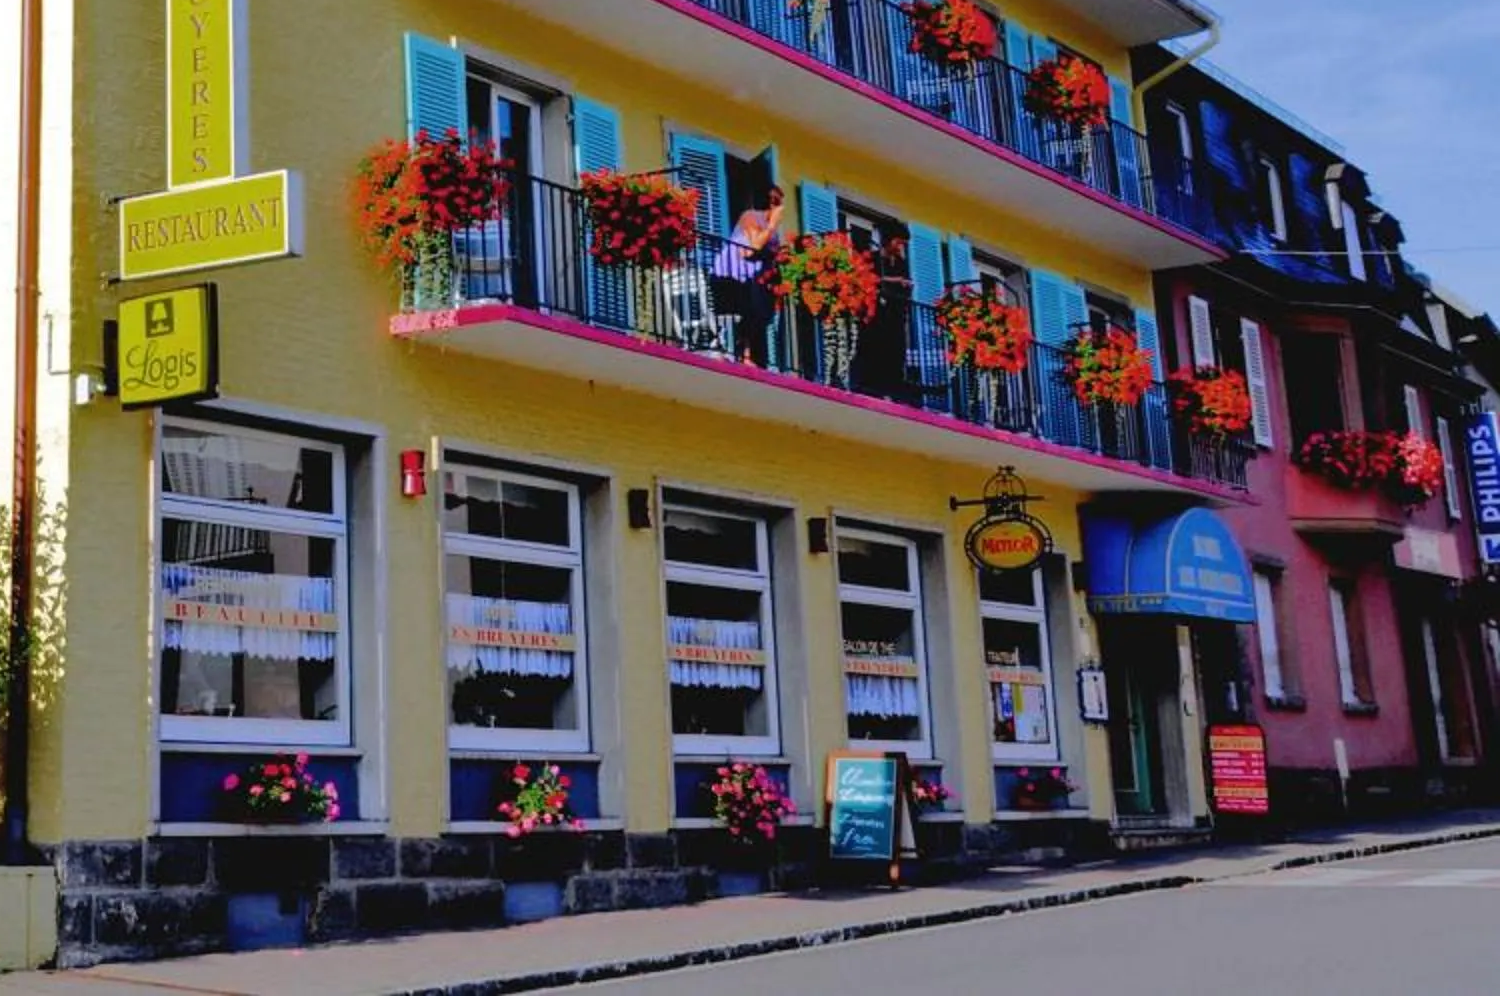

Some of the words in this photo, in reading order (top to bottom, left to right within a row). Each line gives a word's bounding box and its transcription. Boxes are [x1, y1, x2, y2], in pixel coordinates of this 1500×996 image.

[127, 196, 282, 253] RESTAURANT
[122, 340, 197, 391] Logis
[1468, 424, 1500, 523] PHILIPS
